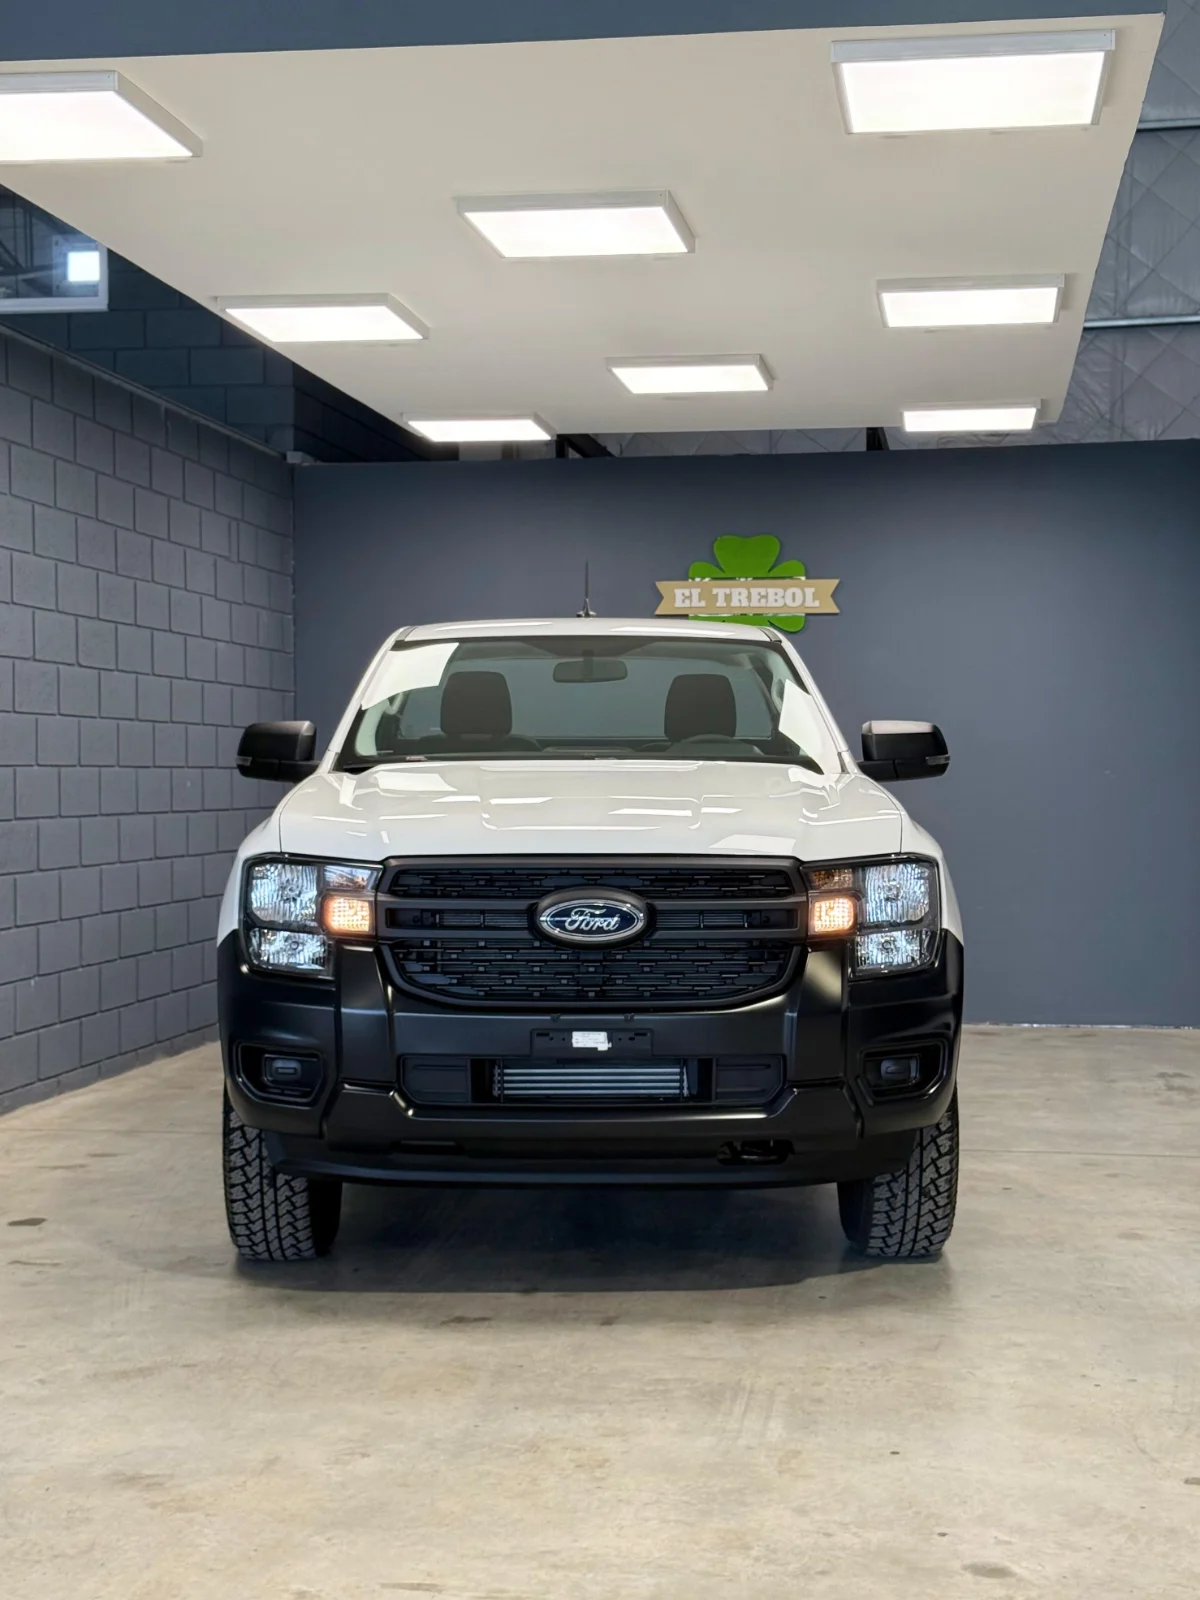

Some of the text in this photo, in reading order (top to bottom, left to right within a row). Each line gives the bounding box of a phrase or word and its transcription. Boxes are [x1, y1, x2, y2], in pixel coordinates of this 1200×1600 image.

[674, 587, 820, 608] EL TREBOL
[564, 907, 620, 931] Ford
